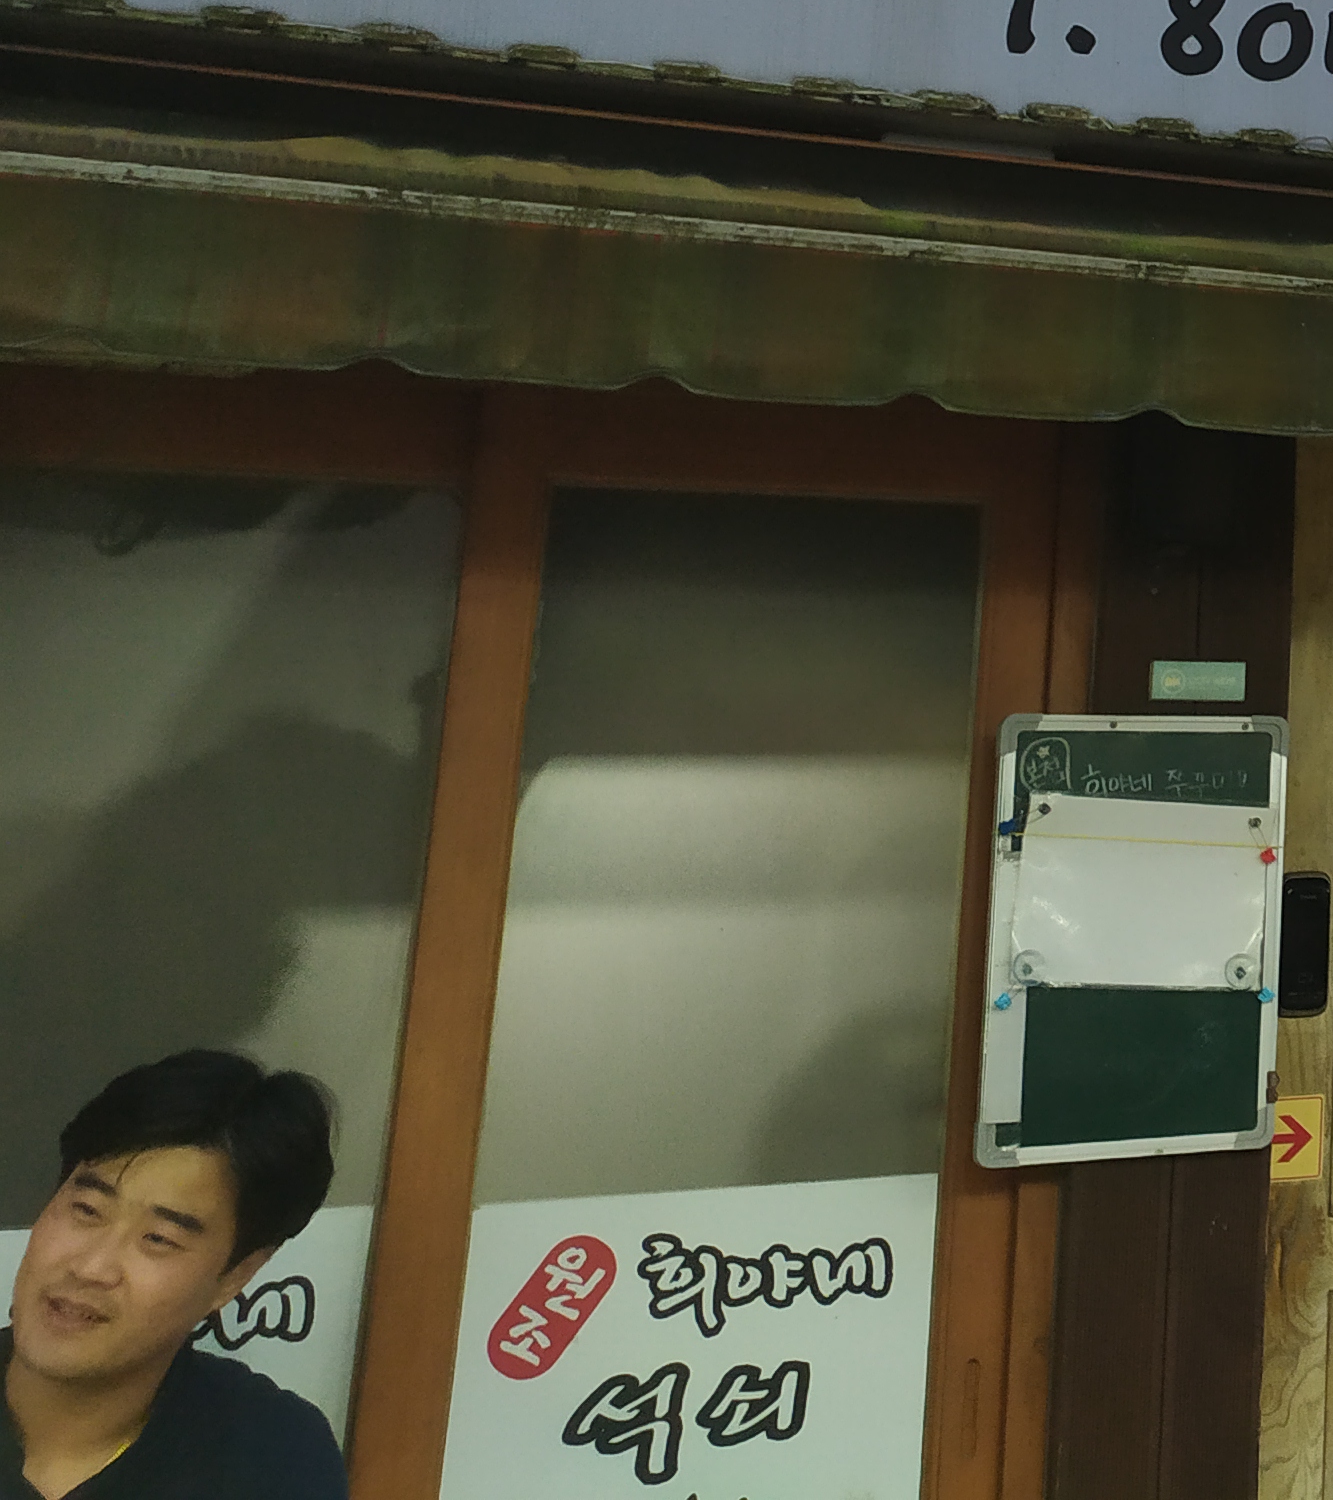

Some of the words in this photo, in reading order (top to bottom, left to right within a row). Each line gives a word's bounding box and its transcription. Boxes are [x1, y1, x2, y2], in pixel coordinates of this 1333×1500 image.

[500, 1247, 605, 1367] 원조
[637, 1233, 894, 1339] 희야네
[561, 1360, 811, 1485] 석쇠
